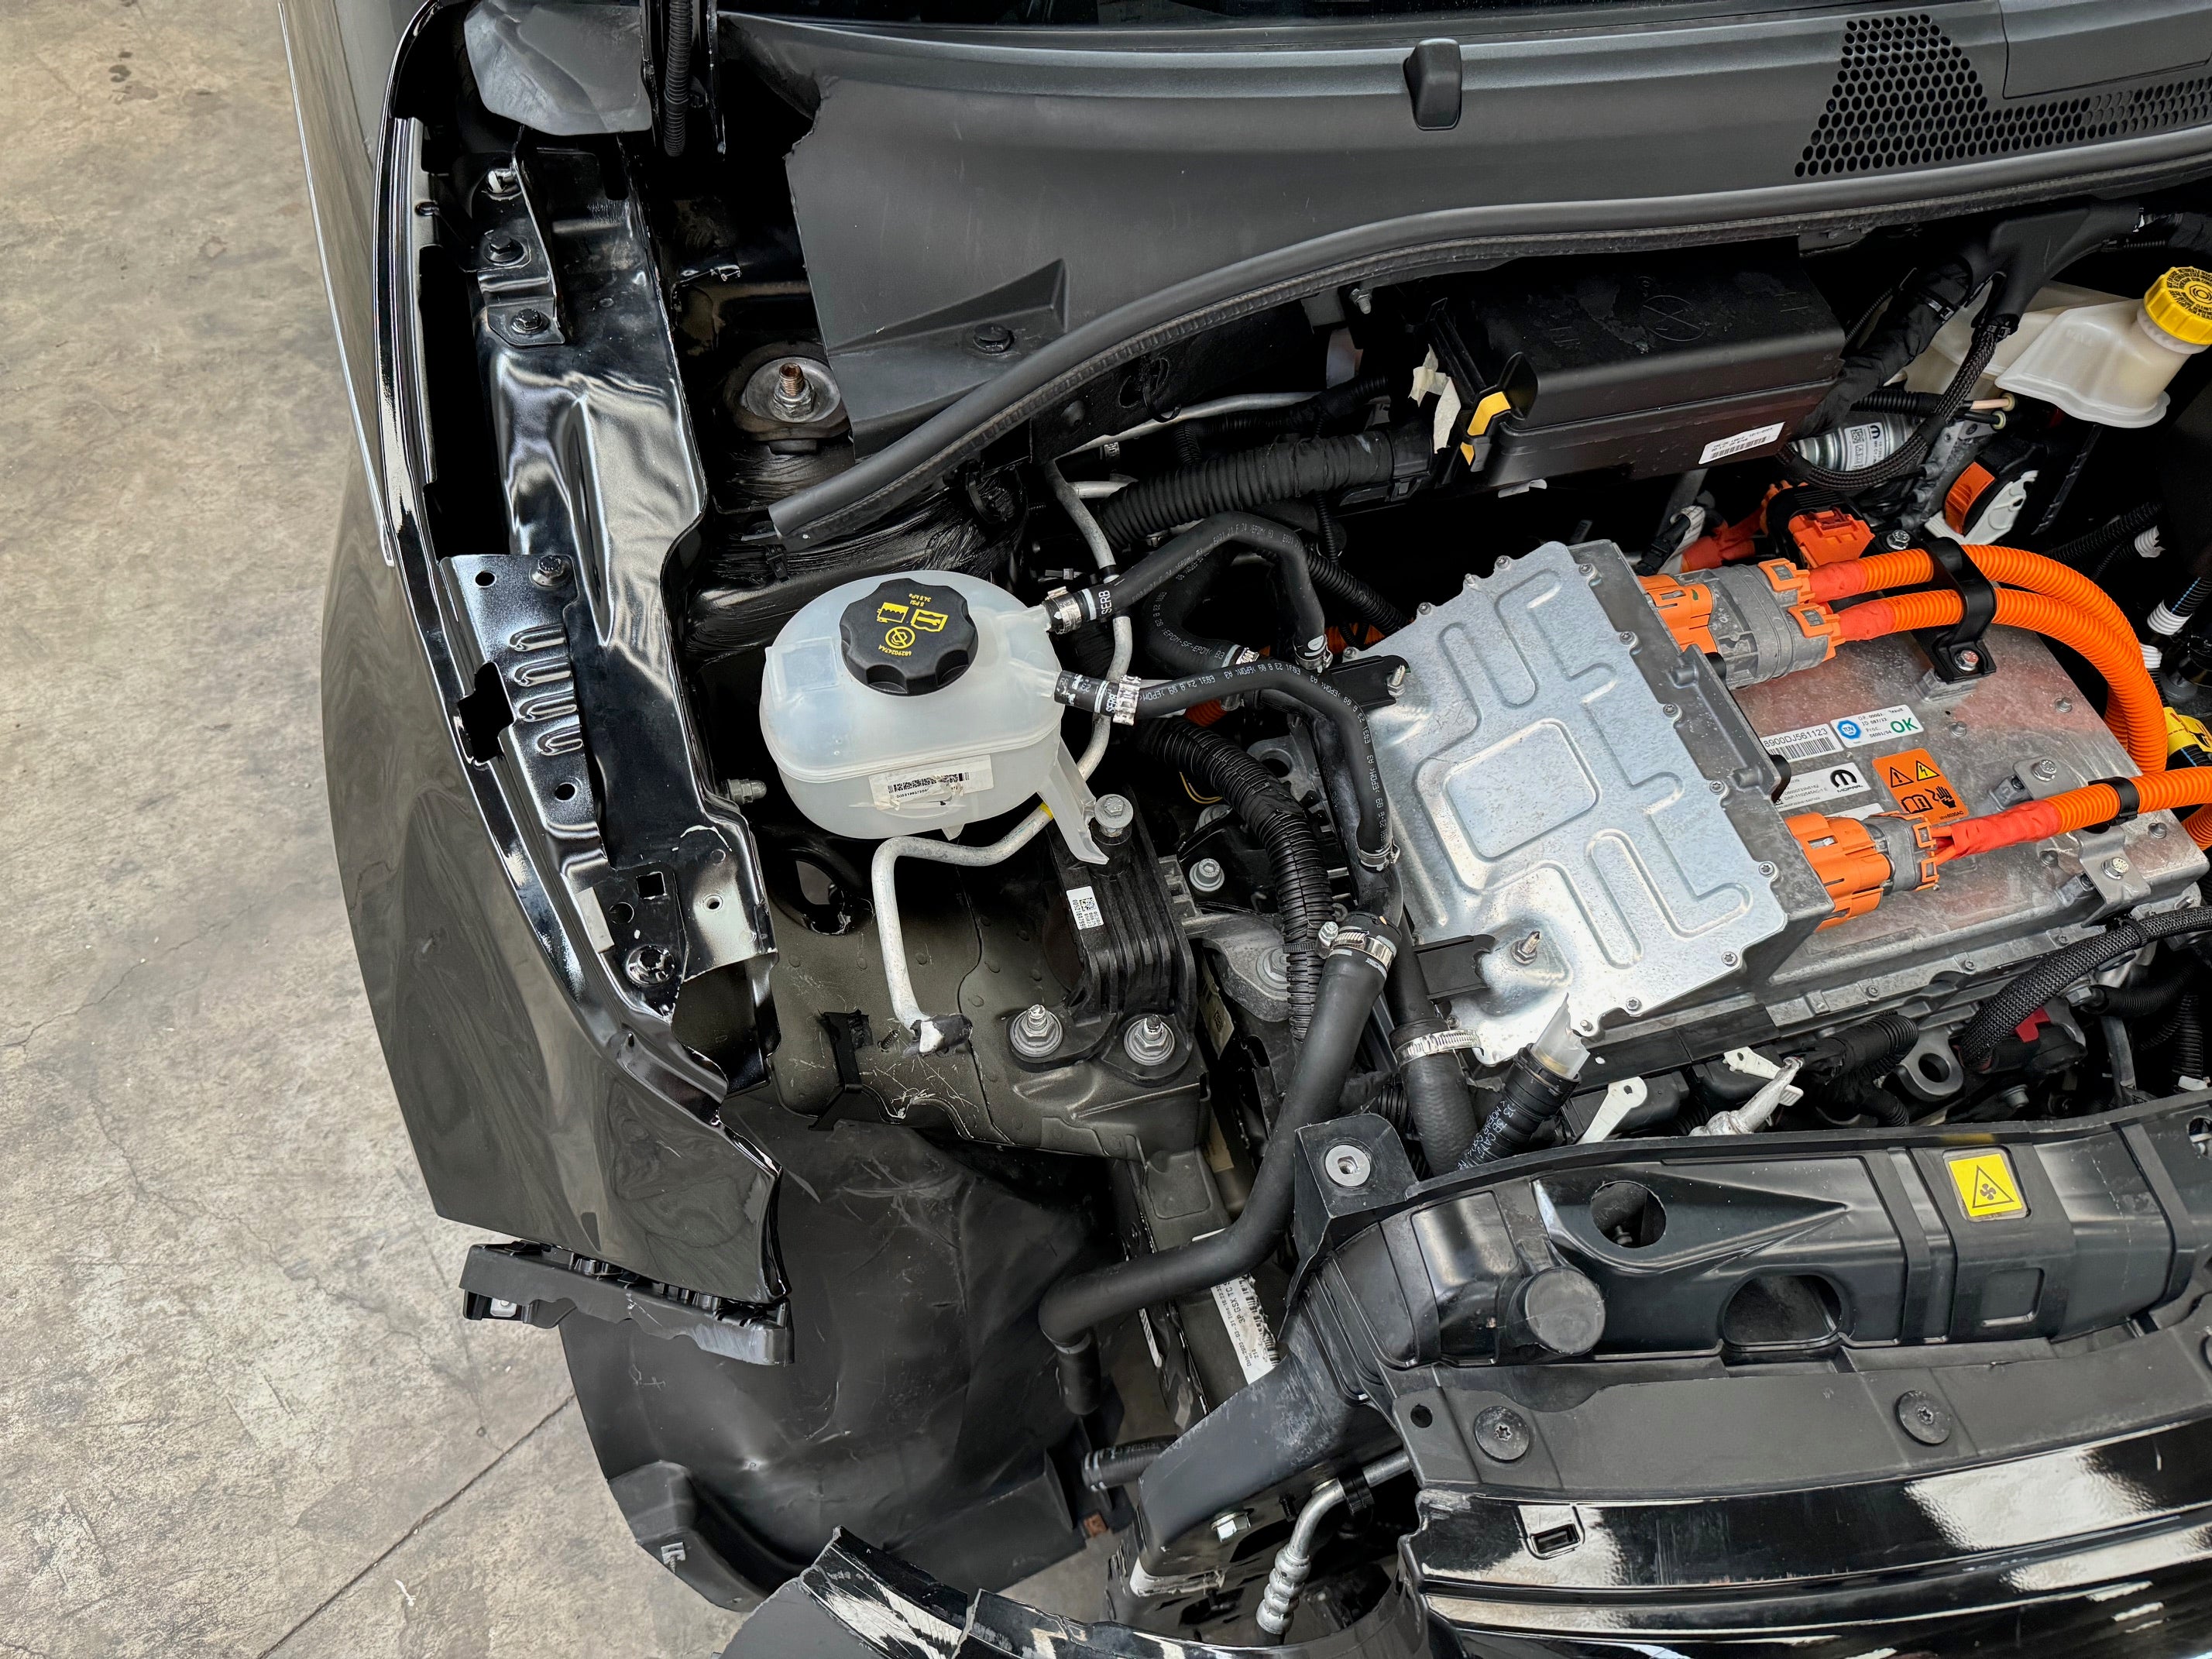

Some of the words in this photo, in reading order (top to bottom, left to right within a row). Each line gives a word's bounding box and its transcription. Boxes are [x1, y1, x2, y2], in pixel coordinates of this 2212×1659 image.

[1098, 589, 1112, 615] SERB
[1890, 717, 1919, 733] OK
[1764, 728, 1828, 747] 8900DJ561123
[1230, 1297, 1241, 1313] GSX
